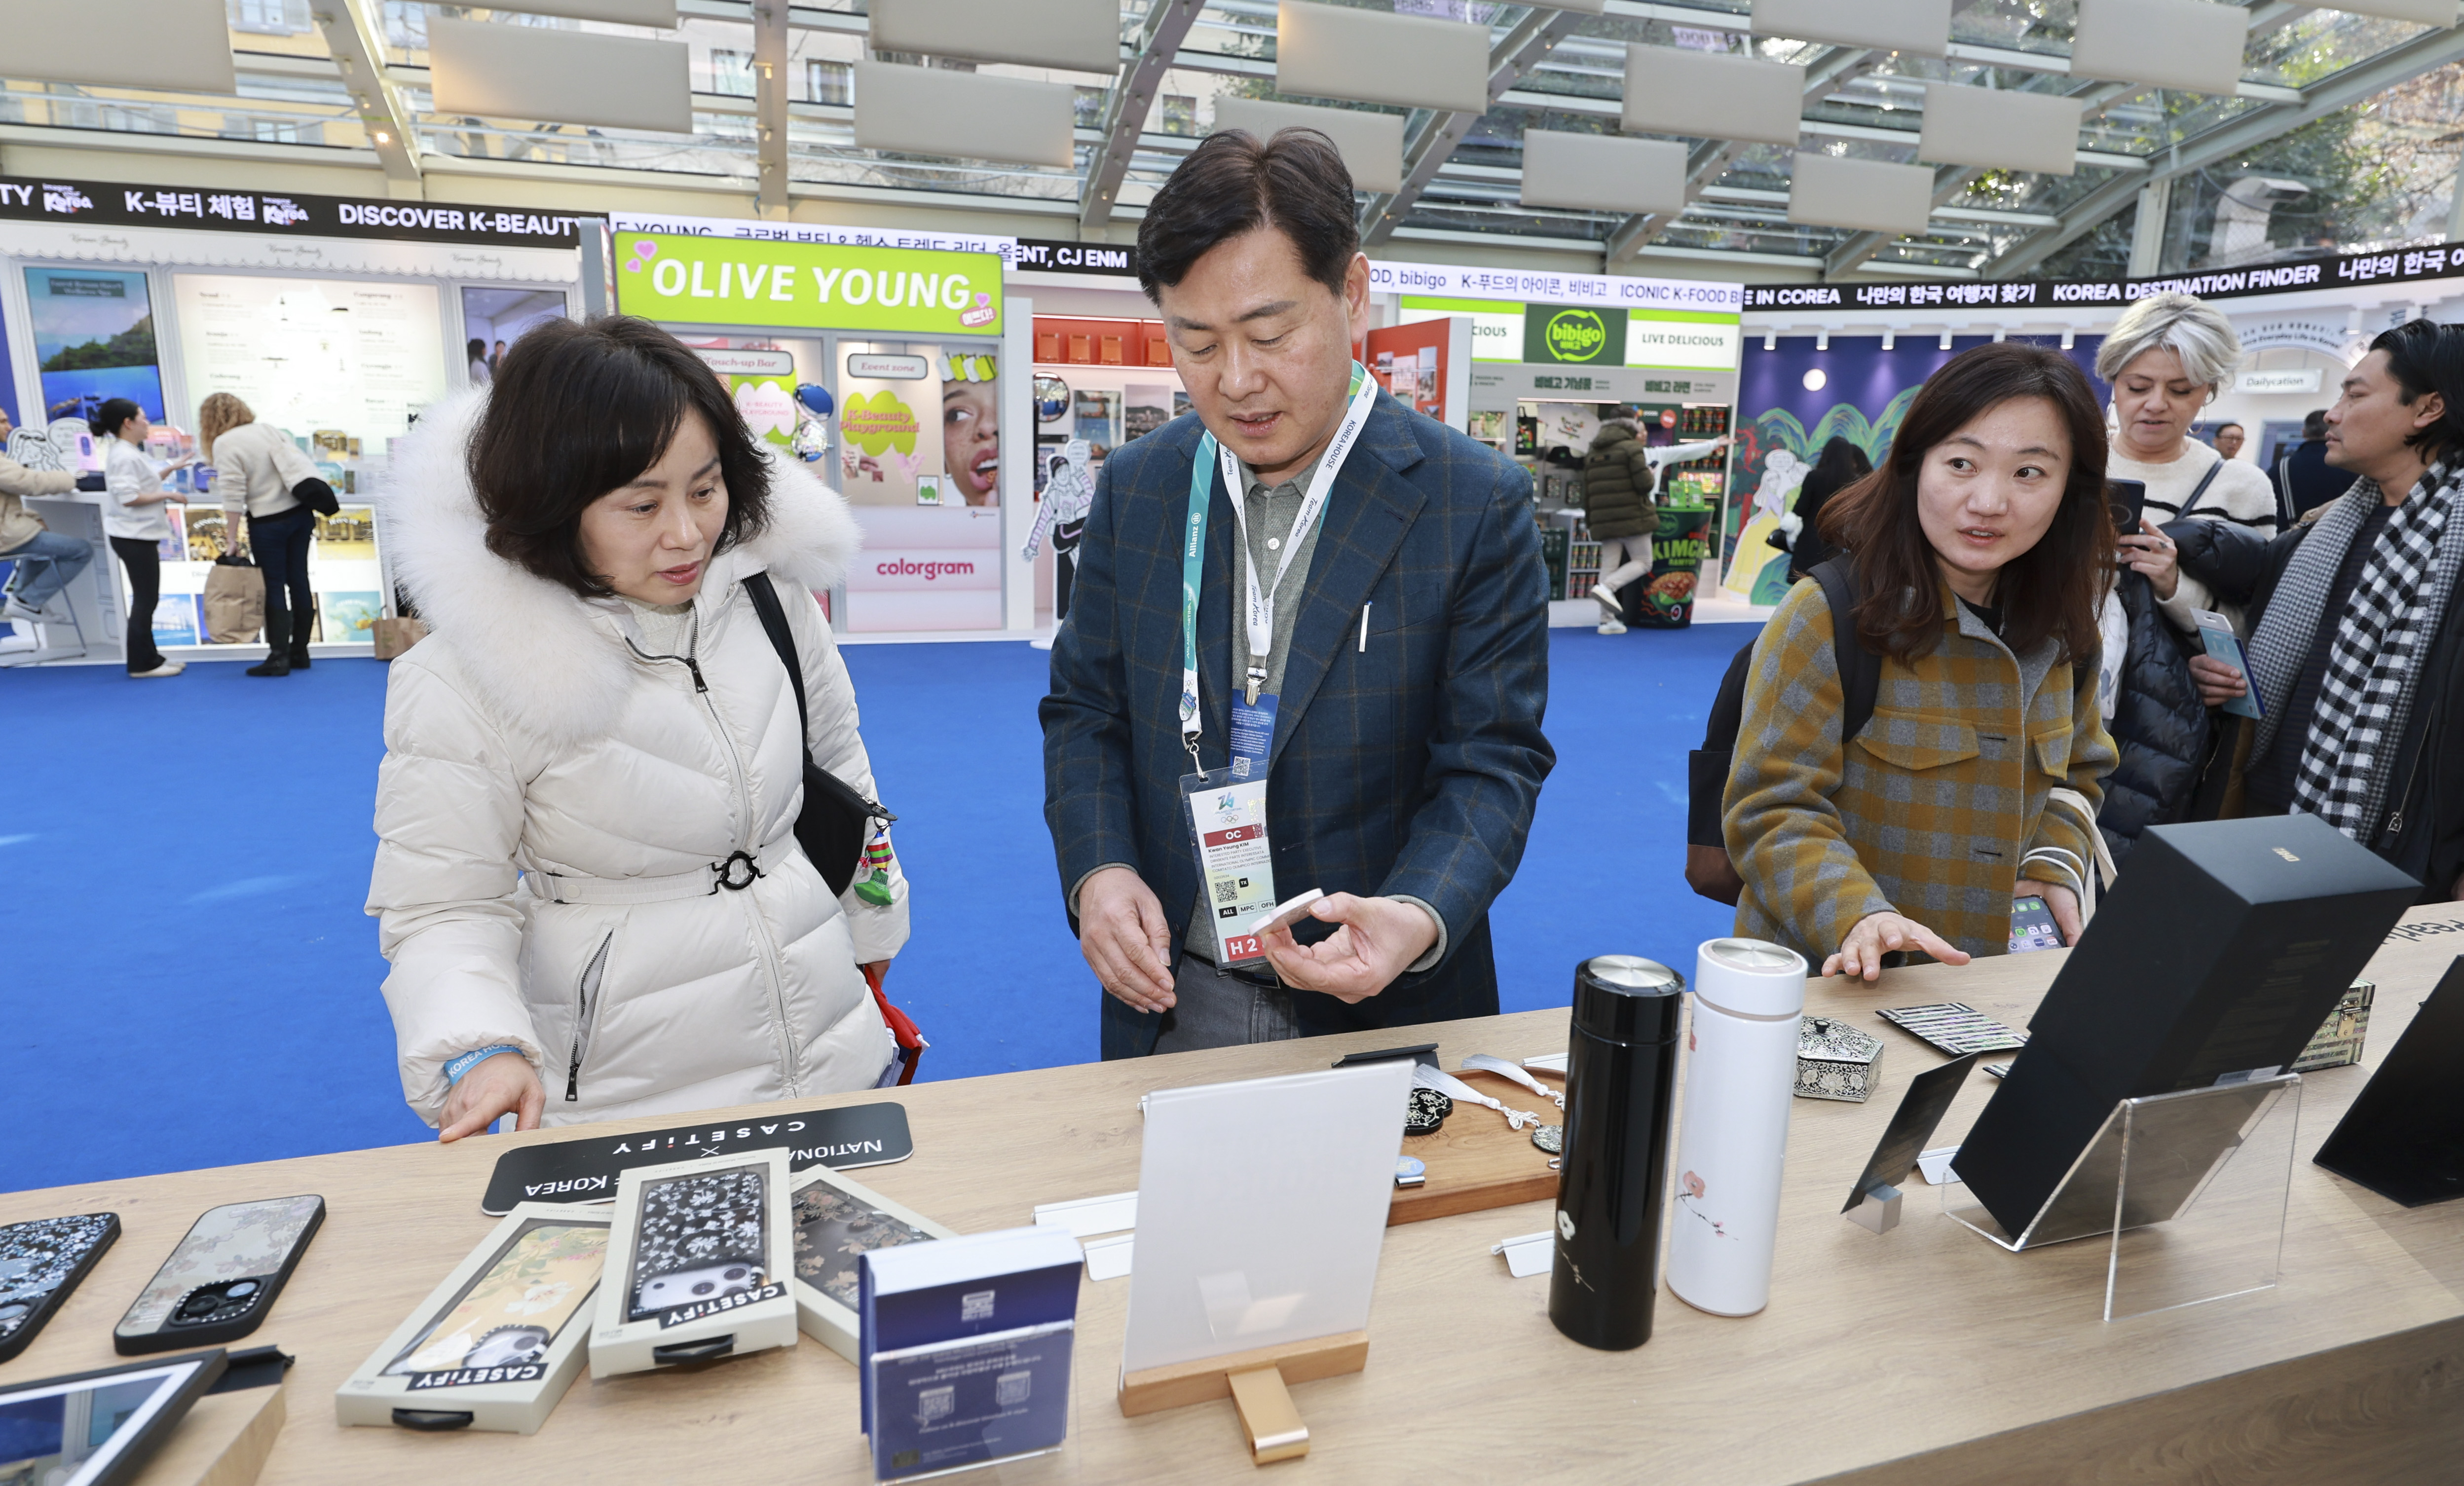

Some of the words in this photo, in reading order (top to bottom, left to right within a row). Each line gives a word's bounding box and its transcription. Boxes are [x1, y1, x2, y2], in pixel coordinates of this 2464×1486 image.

[124, 191, 203, 218] K-뷰티
[208, 194, 256, 221] 체험
[338, 204, 464, 231] DISCOVER
[469, 212, 581, 236] K-BEAUT
[1057, 248, 1082, 265] CJ
[1085, 249, 1127, 268] ENM
[652, 259, 795, 301] OLIVE
[811, 267, 971, 310] YOUNG
[1400, 271, 1446, 290] bibigo
[1461, 274, 1518, 292] K-푸드의
[1522, 277, 1564, 297] 아이콘,
[1569, 280, 1607, 297] 비비고
[1620, 284, 1670, 300] ICONIC
[1674, 288, 1726, 303] K-FOOD
[1756, 289, 1775, 305] IN
[1857, 286, 1906, 305] 나만의
[1909, 285, 1943, 304] 한국
[1946, 284, 1997, 303] 여행지
[2000, 283, 2036, 303] 찾기
[2053, 283, 2121, 301] KOREA
[2125, 273, 2245, 300] DESTINATION
[2248, 265, 2320, 289] FINDER
[2339, 254, 2399, 280] 나만의
[2404, 250, 2446, 275] 한국
[1552, 323, 1601, 347] bibigo
[1642, 334, 1665, 344] LIVE
[1669, 335, 1724, 347] DELICIOUS
[756, 359, 777, 368] Bar
[861, 363, 889, 372] Event
[2246, 376, 2304, 388] Dailycation
[847, 409, 910, 422] K-Beauty
[839, 421, 920, 433] Playground
[1339, 420, 1356, 443] KOREA
[1326, 443, 1344, 470] HOUSE
[1306, 498, 1318, 516] Team
[1295, 515, 1308, 537] Korea
[1189, 525, 1199, 557] Allianz
[877, 557, 974, 581] colorgram
[1226, 830, 1242, 840] OC
[1211, 860, 1239, 868] INTERNATIONAL
[1230, 941, 1243, 955] H
[1247, 938, 1258, 952] 2
[448, 1051, 483, 1077] KOREA
[524, 1174, 608, 1196] KOREA
